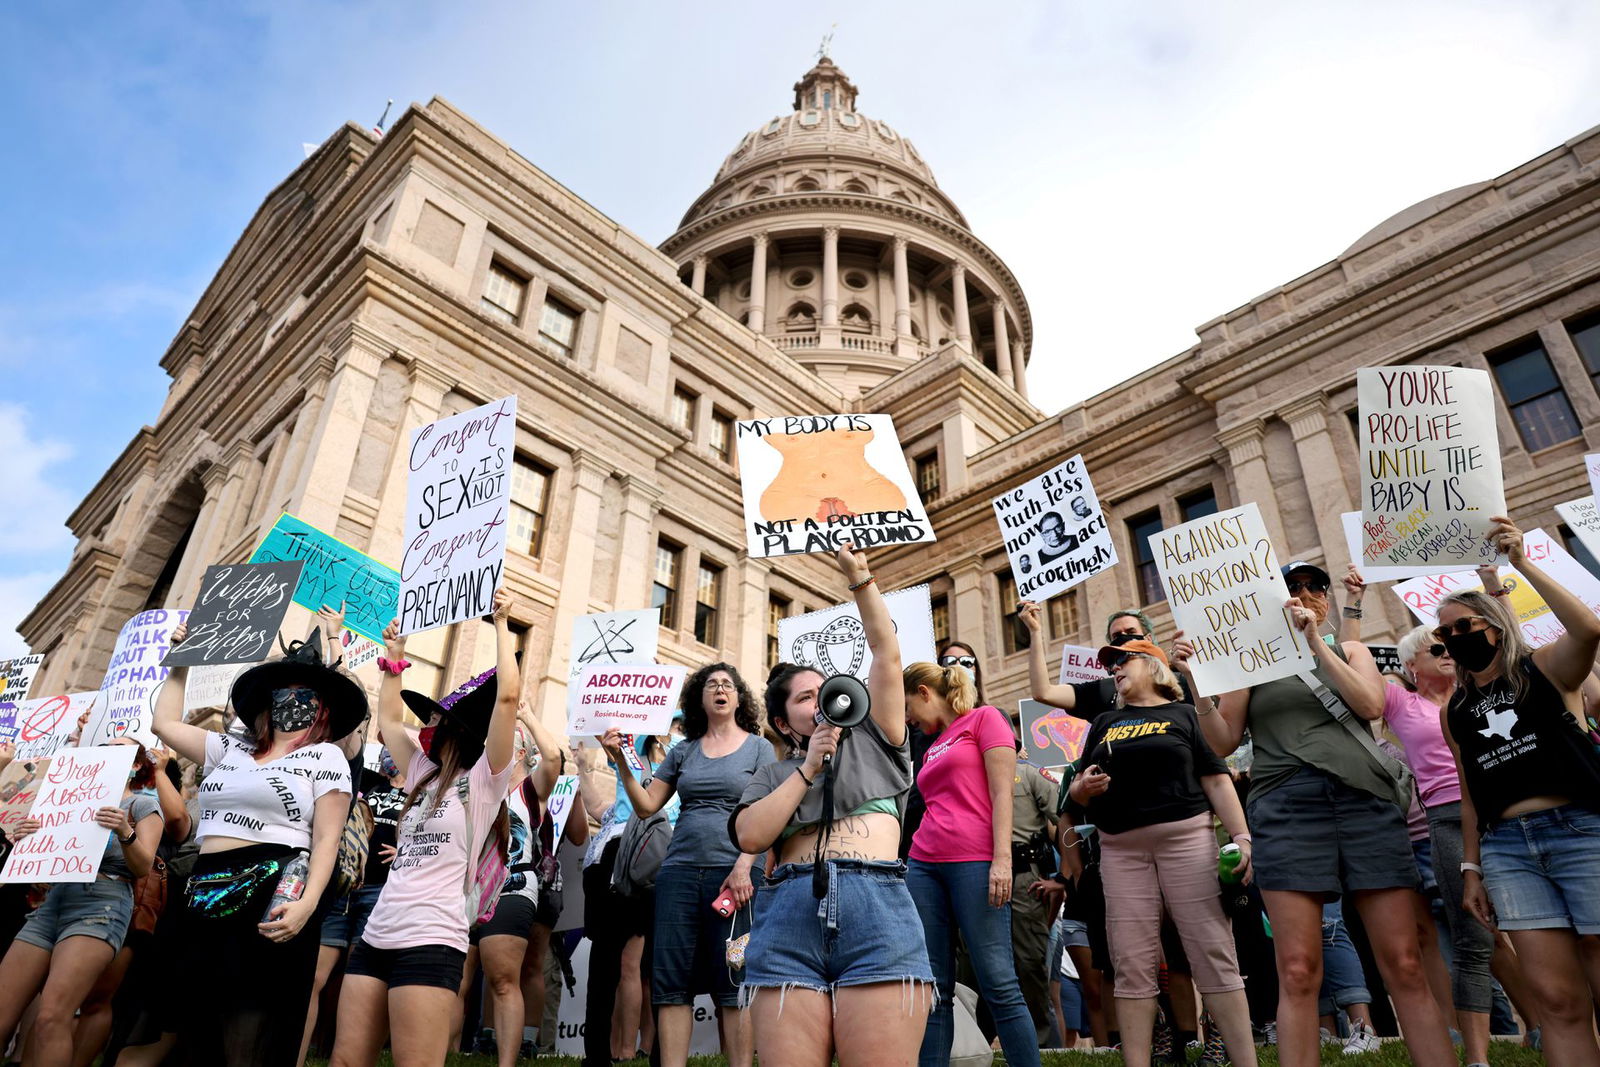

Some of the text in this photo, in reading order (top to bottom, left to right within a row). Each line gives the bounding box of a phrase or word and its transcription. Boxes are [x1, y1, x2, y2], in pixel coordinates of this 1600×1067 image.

[410, 400, 510, 472] Consent
[739, 415, 873, 438] MY BODY IS
[443, 447, 505, 476] TO IS
[1369, 444, 1482, 479] UNTIL THE
[420, 467, 505, 529] SEX NOT
[995, 461, 1078, 511] we are
[1370, 480, 1431, 512] BABY
[754, 508, 923, 537] NOT A POLITICAL
[1006, 515, 1107, 554] now act
[400, 507, 504, 583] Consent
[763, 525, 925, 557] PLAYGROUND
[1162, 514, 1247, 569] AGAINST
[434, 565, 450, 580] TO
[1019, 543, 1112, 597] accordingly
[1168, 539, 1275, 607] ABORTION?
[202, 566, 289, 610] Witches
[296, 571, 386, 630] MY BOX
[400, 559, 503, 634] PREGNANCY
[129, 610, 168, 629] NEED
[214, 609, 250, 622] FOR
[1203, 592, 1261, 633] DON'T
[125, 629, 167, 648] TALK
[172, 623, 267, 661] Bitches
[1191, 628, 1244, 665] HAVE
[20, 656, 40, 665] CALL
[1068, 654, 1081, 667] EL
[114, 684, 148, 701] in the
[586, 674, 673, 689] ABORTION
[581, 694, 668, 706] IS HEALTHCARE
[1471, 690, 1515, 717] TEXAS
[594, 710, 648, 721] RosiesLaw.org
[1099, 721, 1171, 744] JUSTICE
[267, 776, 302, 822] HARLEY
[224, 812, 265, 832] QUINN
[64, 837, 84, 851] a
[8, 856, 93, 878] HOT DOG
